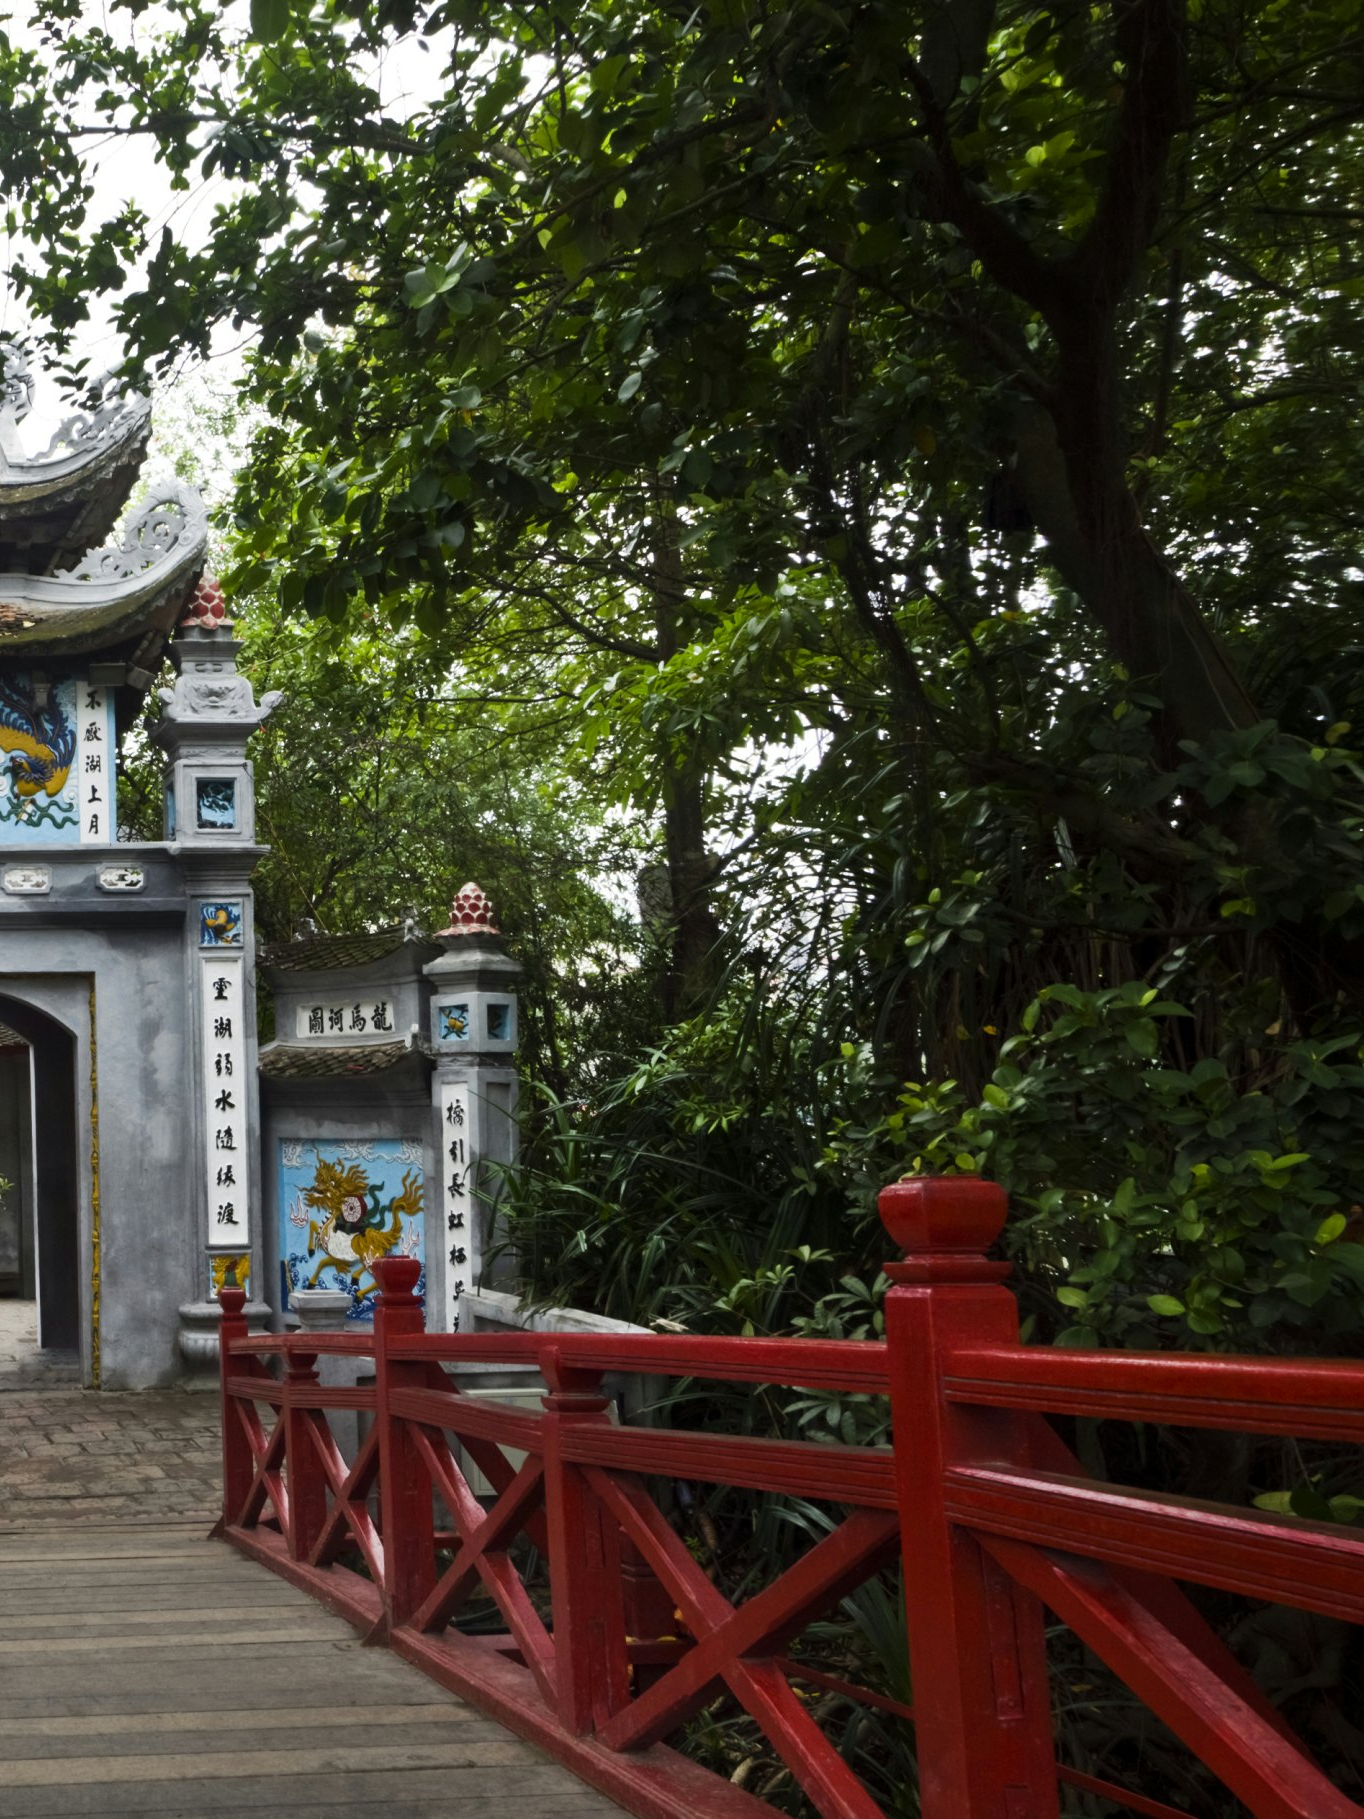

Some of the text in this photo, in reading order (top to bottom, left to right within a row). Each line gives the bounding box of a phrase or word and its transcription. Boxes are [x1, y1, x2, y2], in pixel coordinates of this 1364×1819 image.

[84, 690, 102, 835] 不厭湖上月
[308, 1001, 392, 1034] 龍馬河圖
